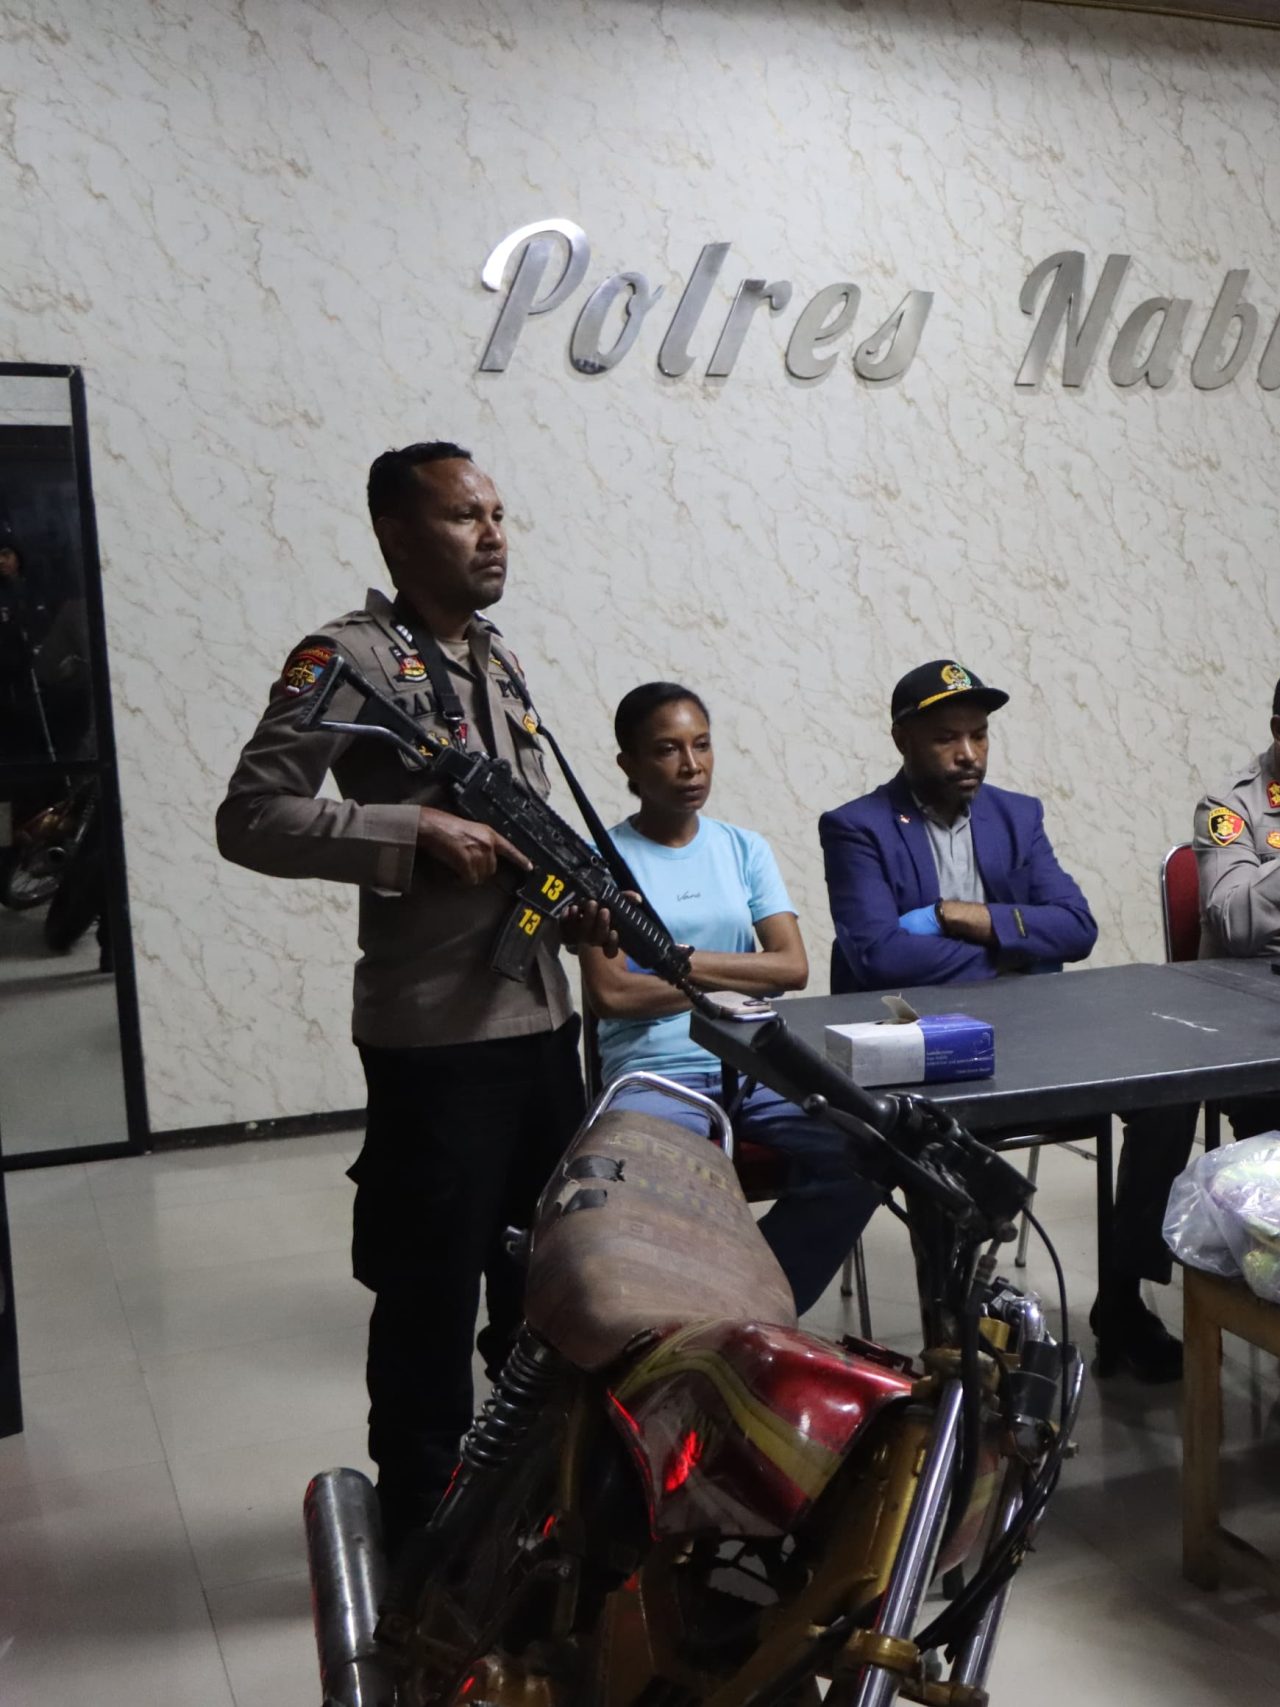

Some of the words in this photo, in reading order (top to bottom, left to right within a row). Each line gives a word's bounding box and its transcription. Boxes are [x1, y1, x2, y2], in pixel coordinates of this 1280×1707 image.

[479, 218, 935, 380] Polres
[541, 874, 566, 901] 13
[518, 908, 542, 936] 13
